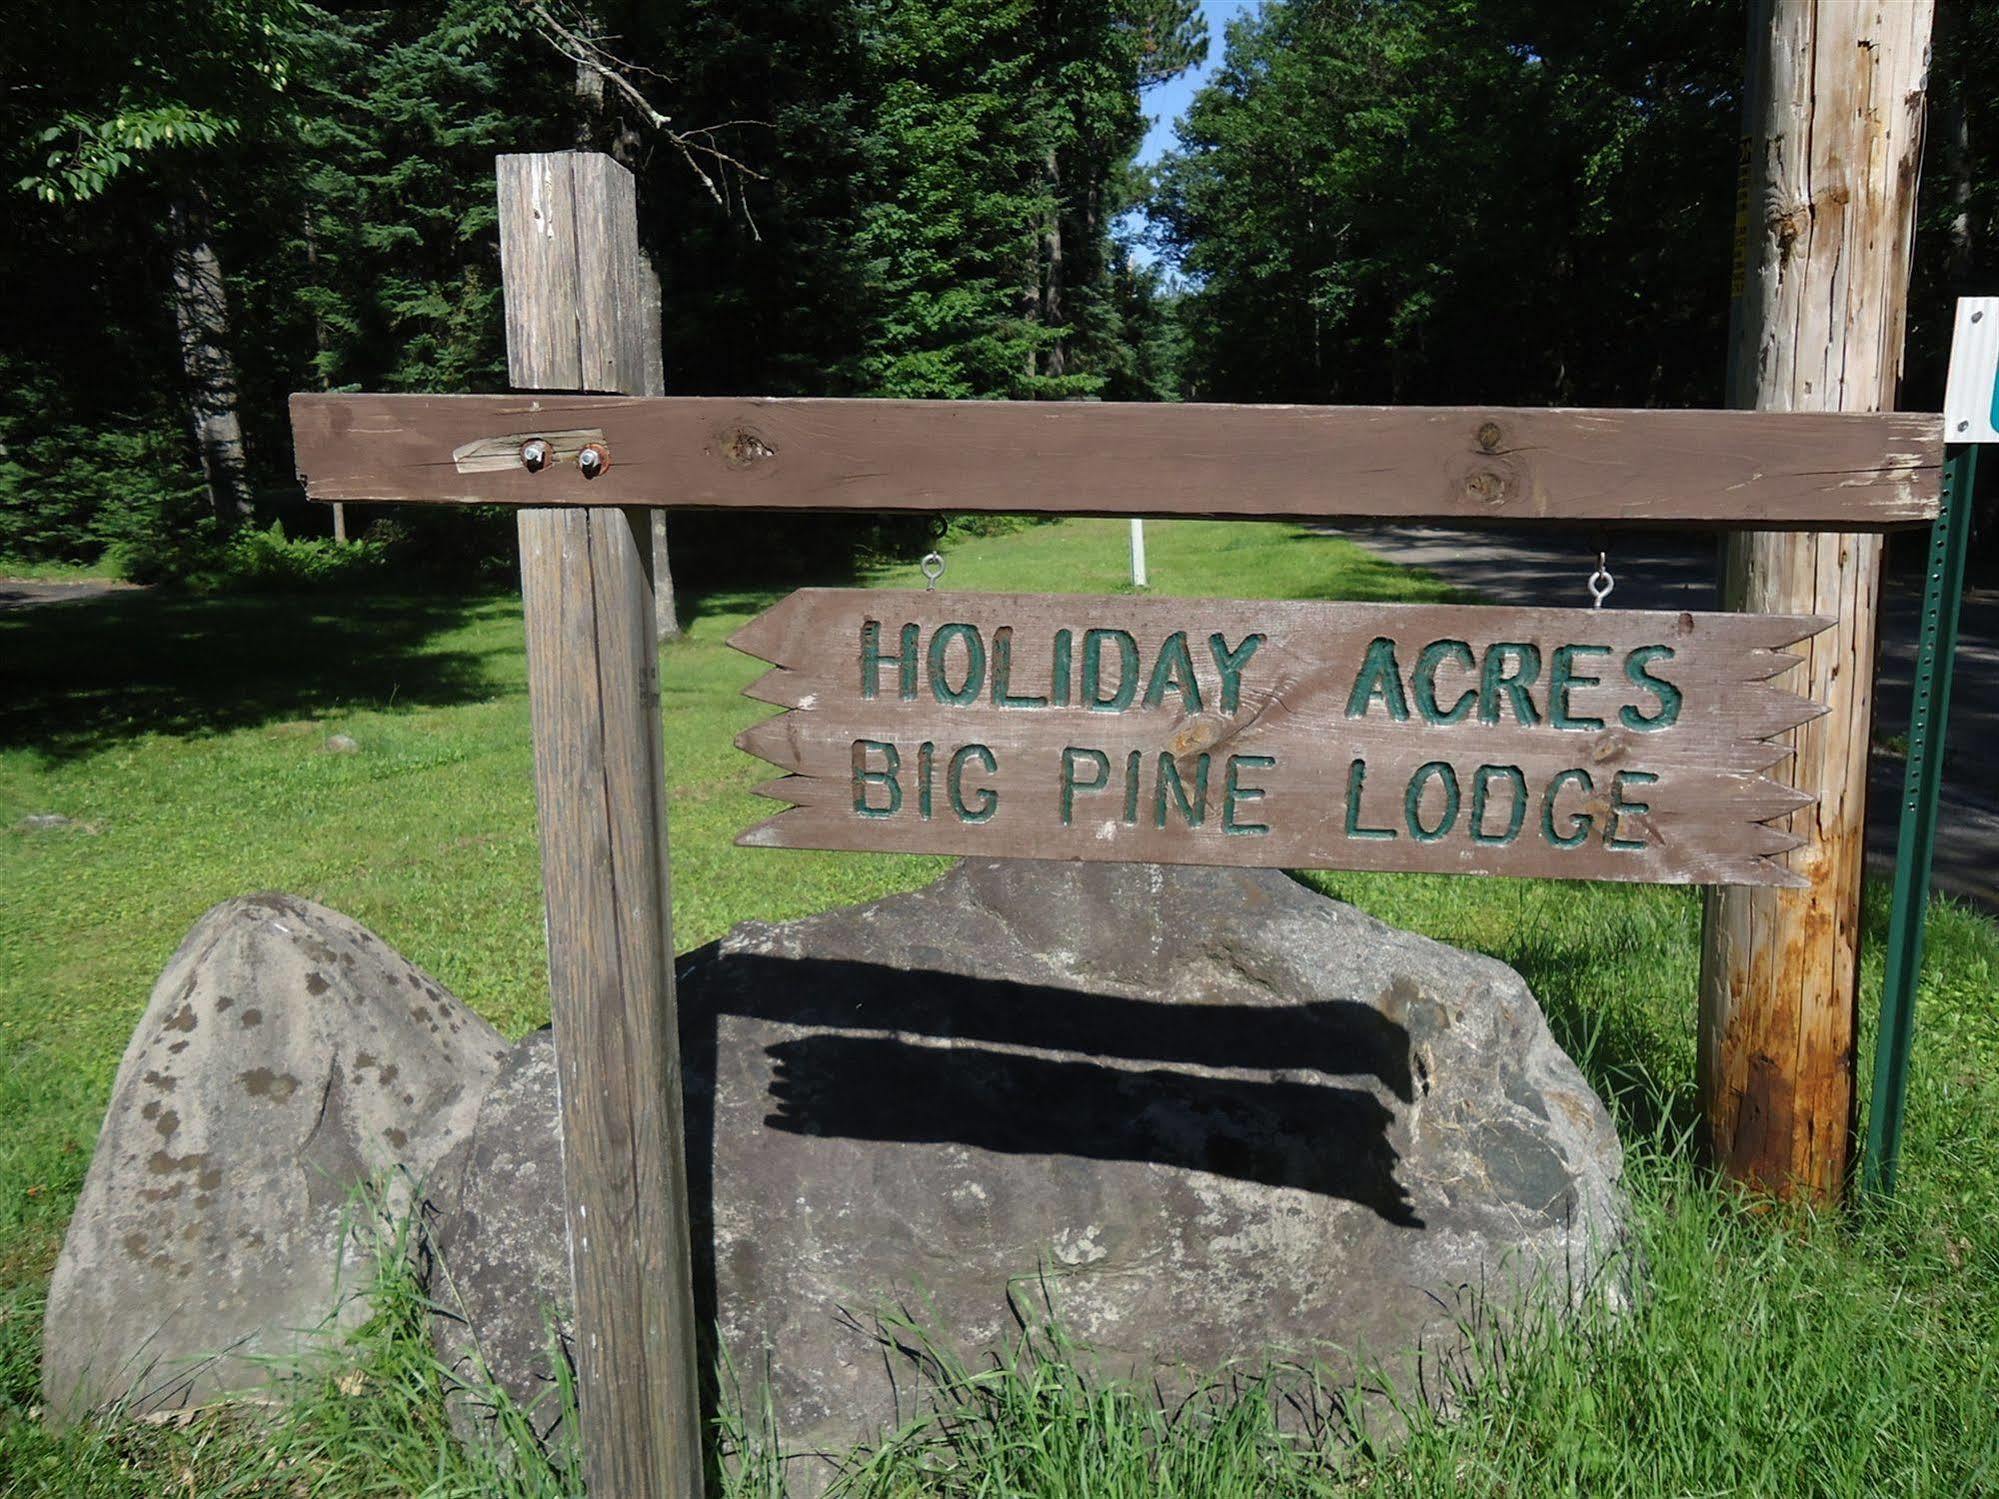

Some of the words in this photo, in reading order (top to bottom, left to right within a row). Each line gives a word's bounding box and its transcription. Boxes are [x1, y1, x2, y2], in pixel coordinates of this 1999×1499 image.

[860, 618, 1268, 716] HOLIDAY
[1345, 636, 1683, 733] ACRES
[851, 738, 998, 824] BIG
[1059, 745, 1276, 836] PINE
[1345, 757, 1660, 850] LODGE
